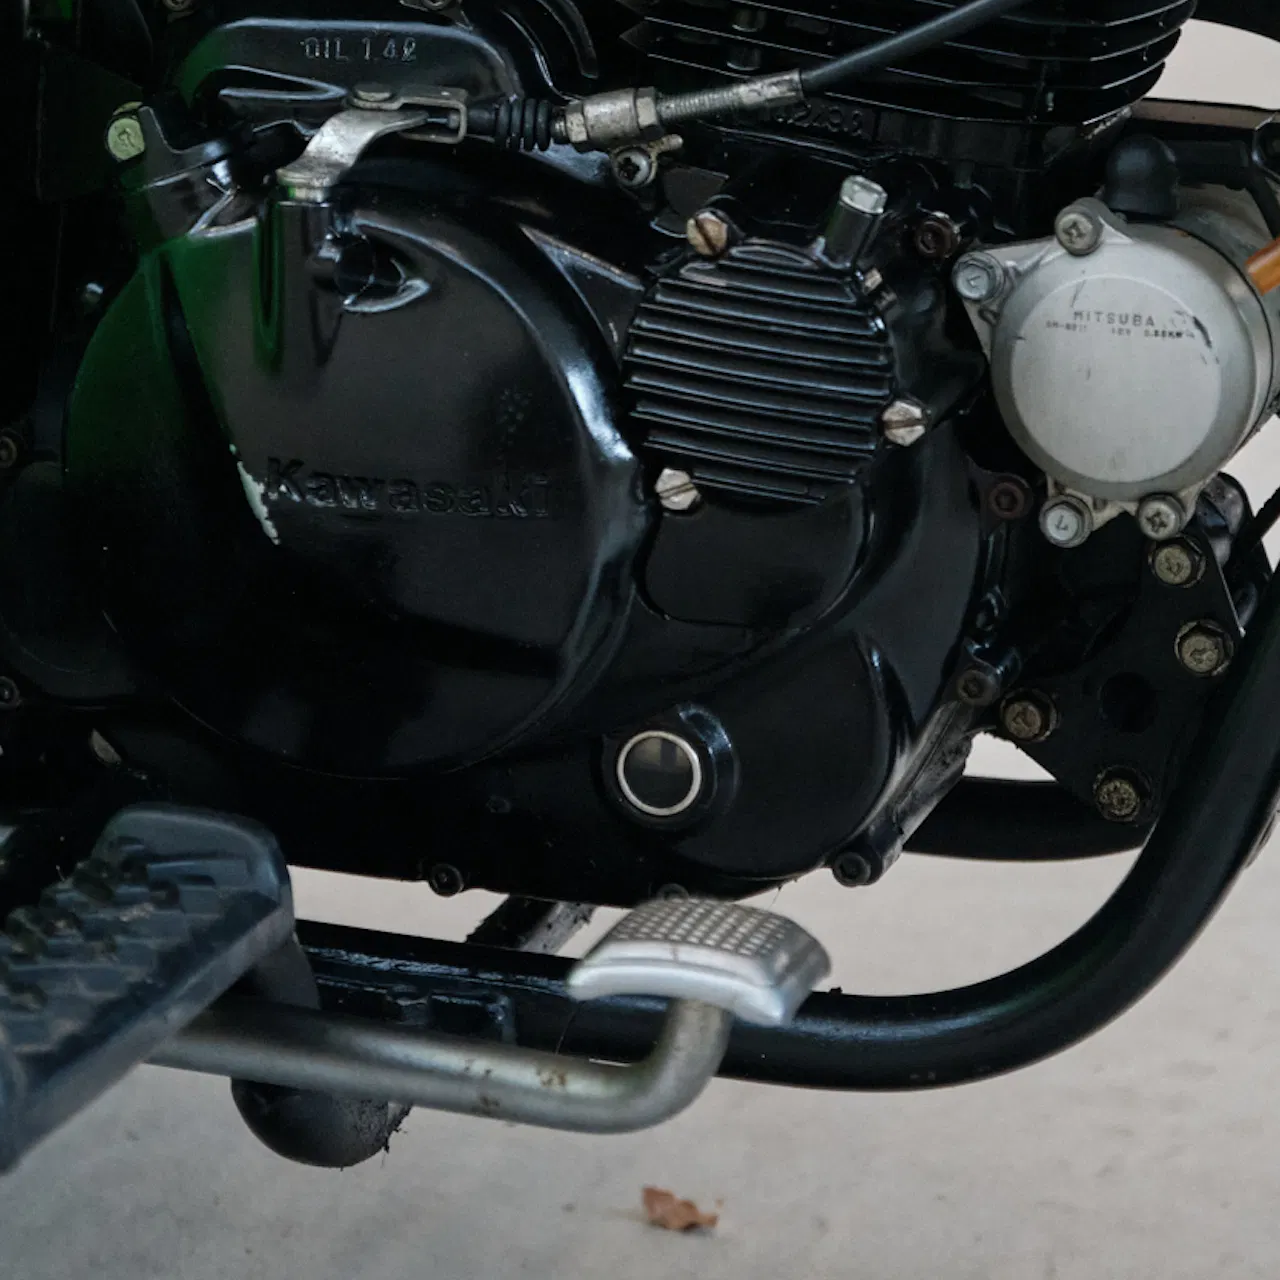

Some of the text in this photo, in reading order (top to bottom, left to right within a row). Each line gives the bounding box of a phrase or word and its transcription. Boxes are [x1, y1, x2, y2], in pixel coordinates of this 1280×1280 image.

[302, 36, 352, 62] OIL
[1073, 310, 1156, 327] MITSUBA
[265, 456, 551, 518] Kawasaki
